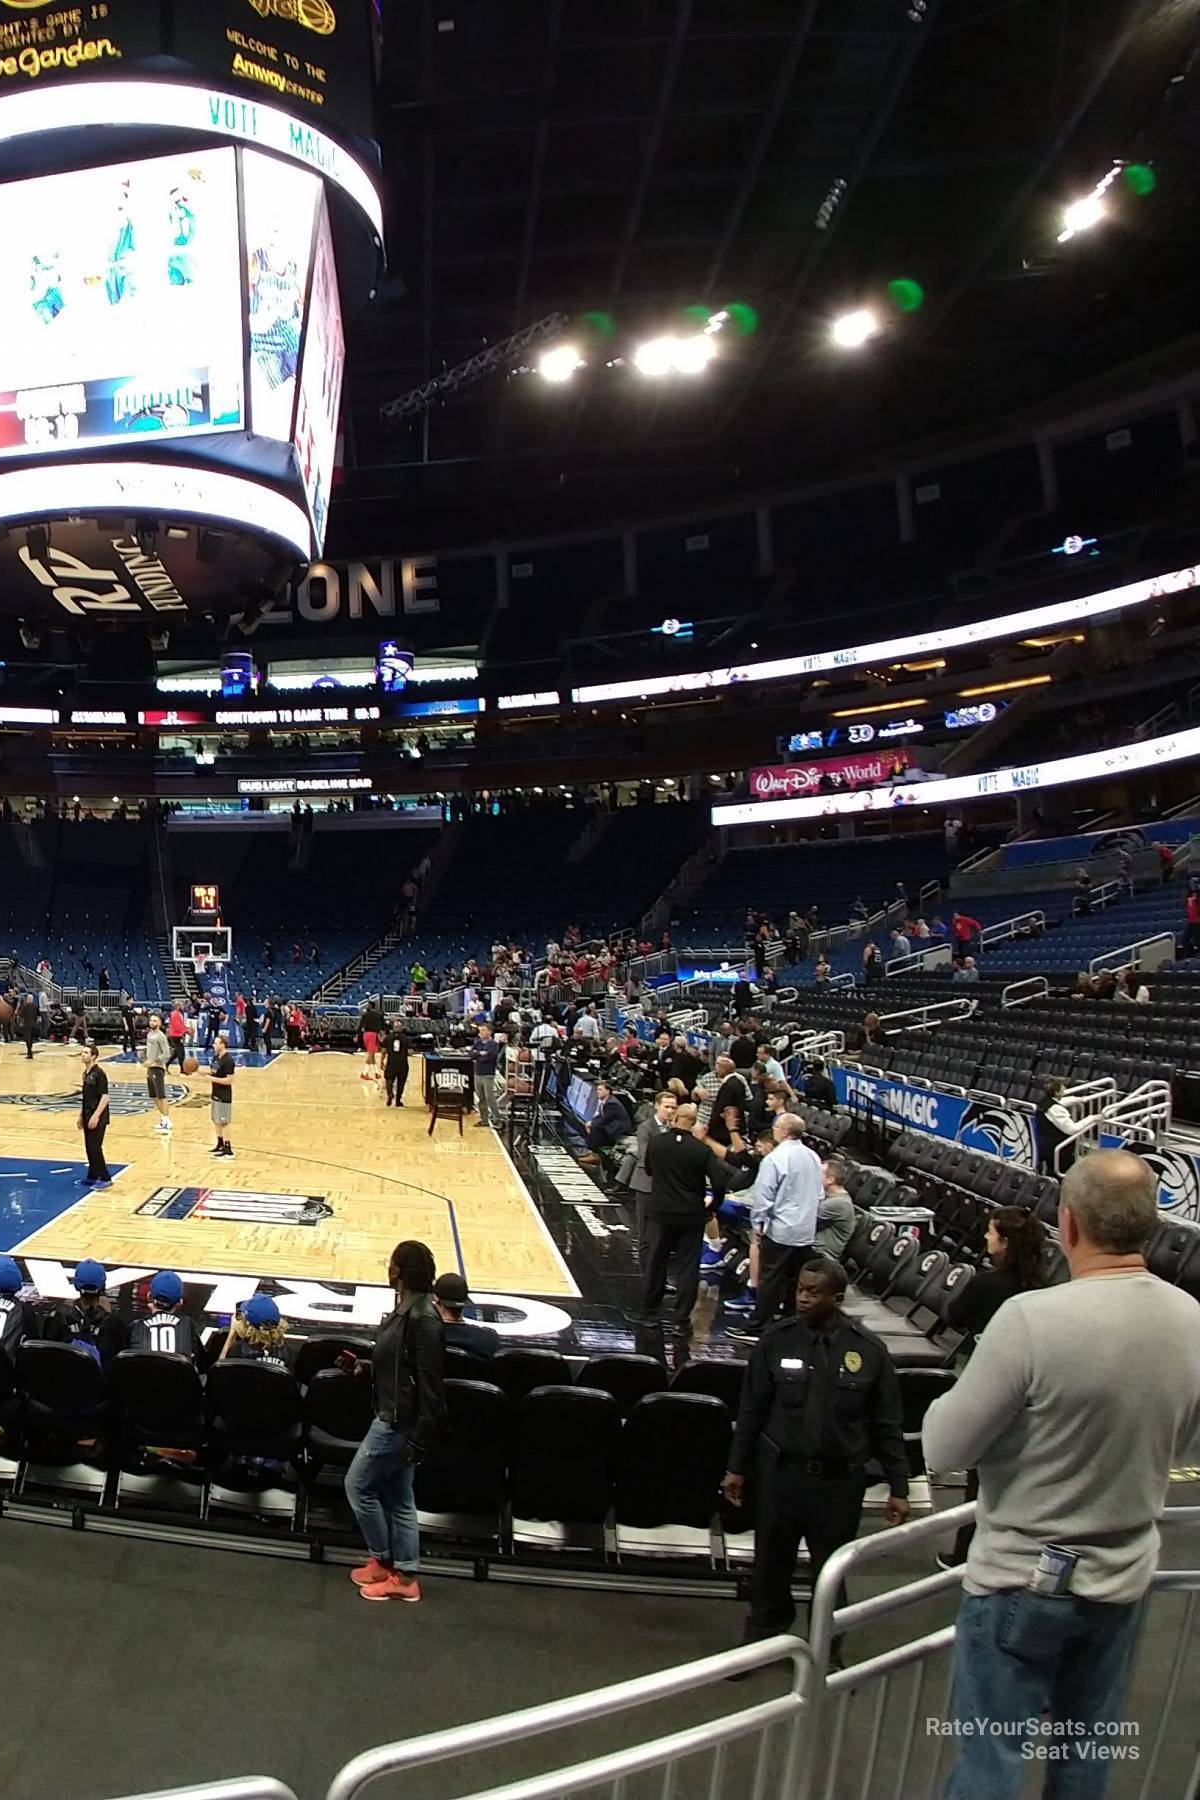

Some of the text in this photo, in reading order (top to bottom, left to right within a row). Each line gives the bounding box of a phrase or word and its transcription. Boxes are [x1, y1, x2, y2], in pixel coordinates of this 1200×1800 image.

[46, 8, 82, 28] GAME
[226, 27, 327, 83] WELCOME TO THE
[233, 53, 325, 105] Amway CENTER
[215, 709, 277, 724] COUNTDOWN
[278, 709, 292, 722] TO
[323, 707, 349, 721] TIME
[349, 778, 373, 789] BAR
[201, 896, 214, 908] 14
[890, 1087, 939, 1129] MAGIC
[921, 1253, 939, 1273] G
[946, 1267, 964, 1287] G
[150, 1326, 176, 1354] 10
